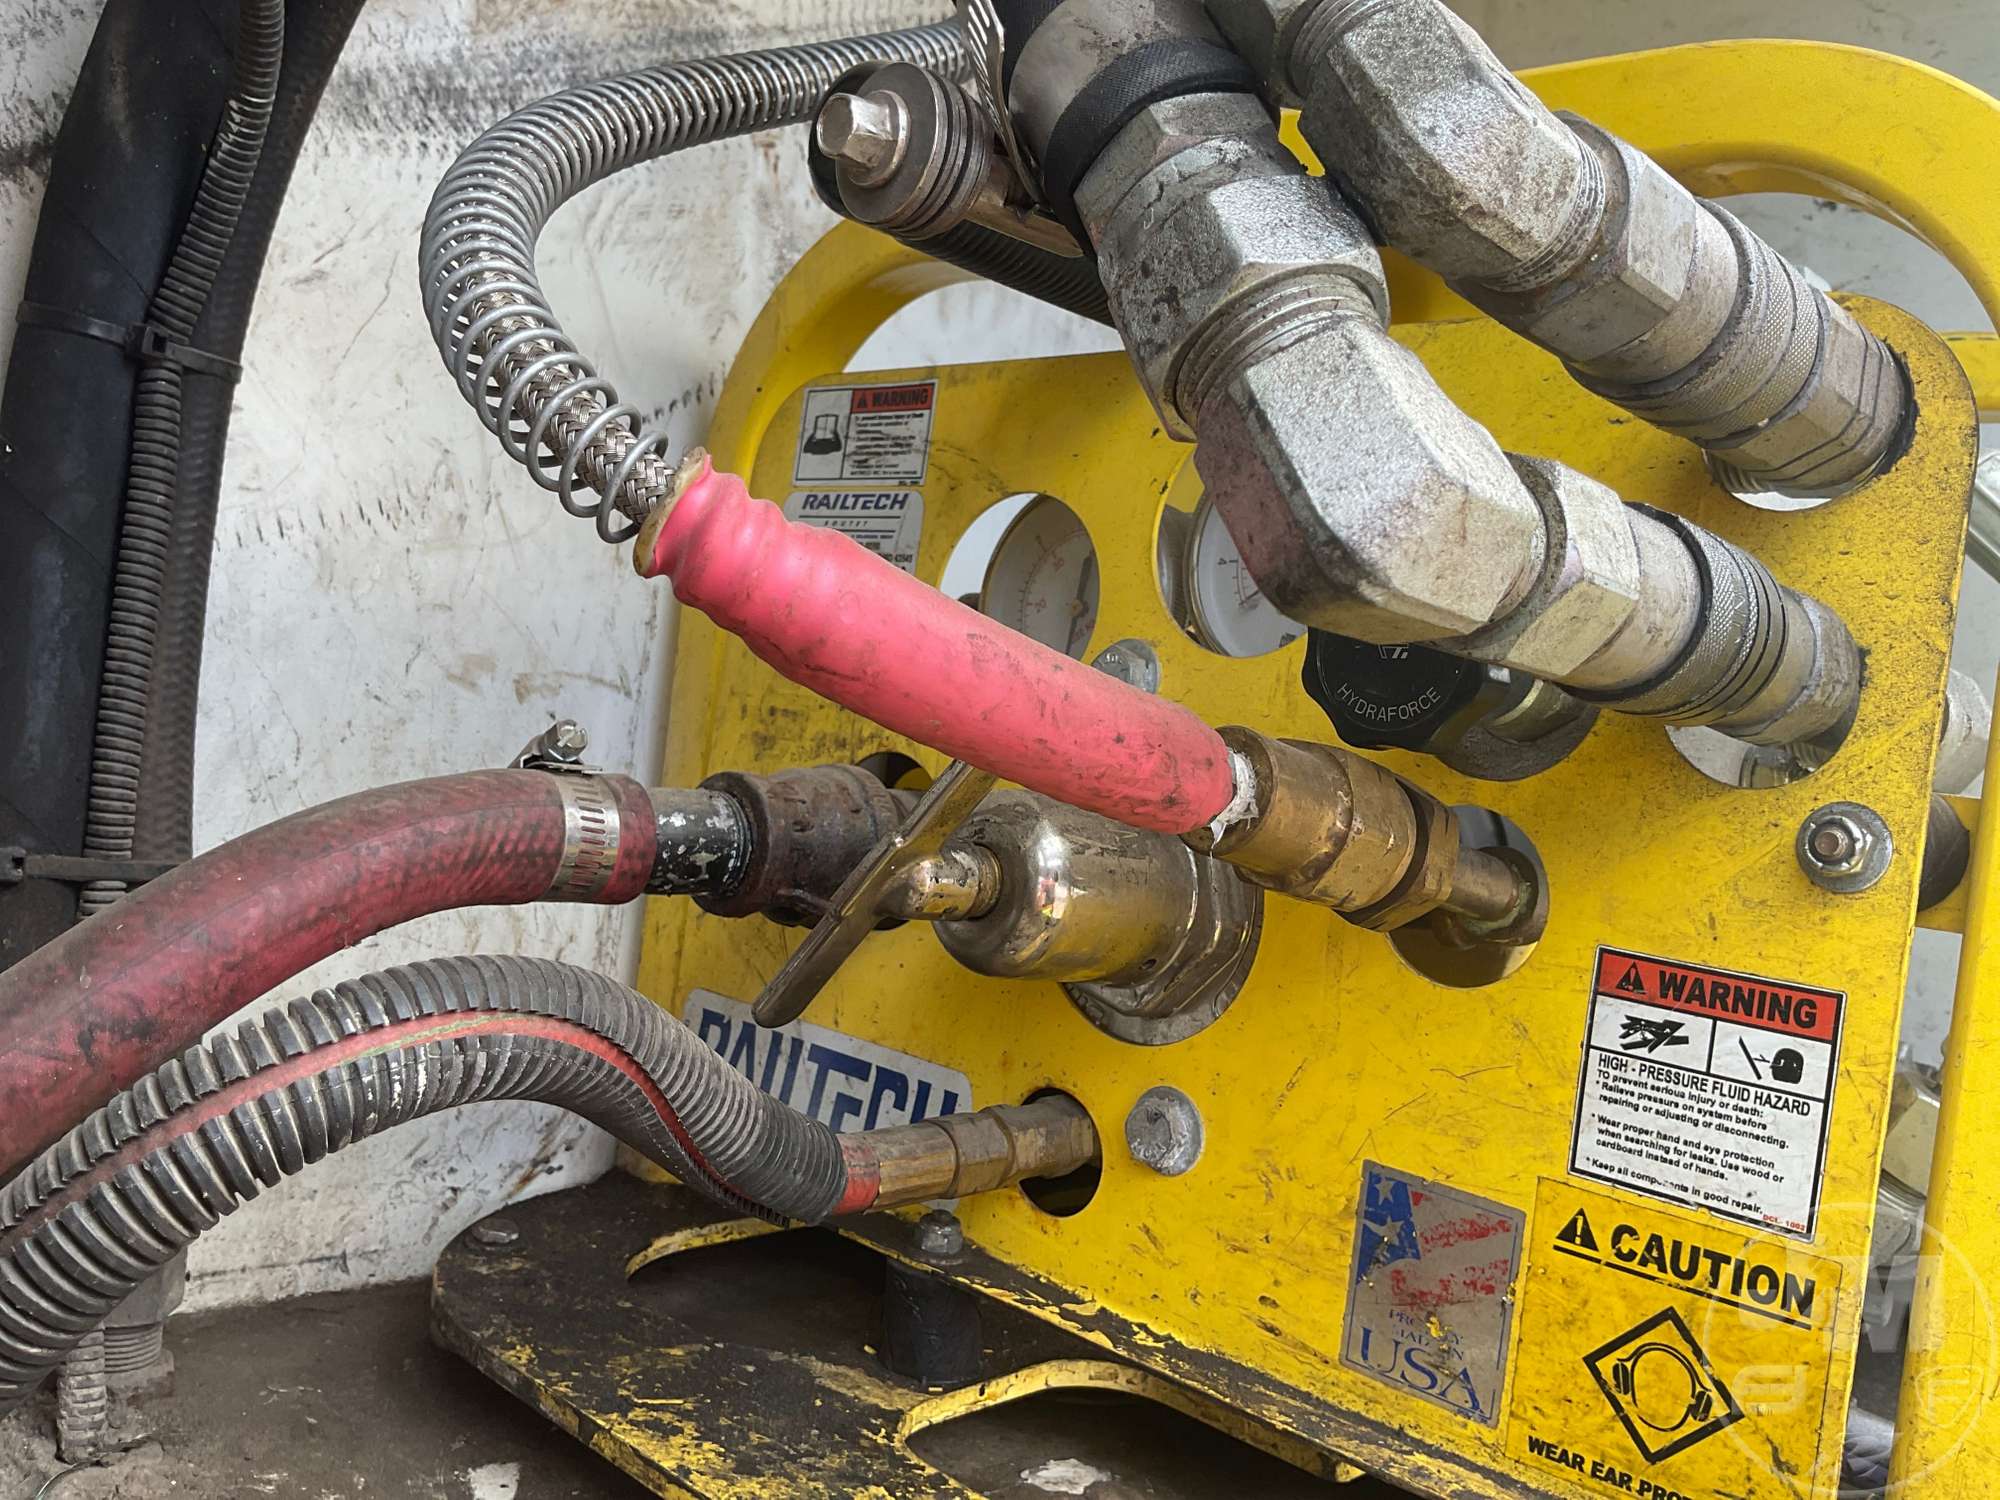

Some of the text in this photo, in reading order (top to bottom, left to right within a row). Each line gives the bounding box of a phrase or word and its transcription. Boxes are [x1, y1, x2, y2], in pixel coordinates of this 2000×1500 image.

[872, 388, 928, 409] WARNING
[802, 493, 909, 510] RAILTECH
[1336, 683, 1441, 722] HYDRAFORCE
[1659, 970, 1817, 1029] WARNING
[1598, 1053, 1629, 1073] HIGH
[1638, 1063, 1709, 1093] PRESSURE
[1711, 1080, 1751, 1102] FLUID
[1753, 1090, 1811, 1116] HAZARD
[1612, 1075, 1648, 1090] prevent
[1650, 1084, 1686, 1099] serious
[1688, 1091, 1717, 1108] injury
[1718, 1101, 1730, 1109] or
[1732, 1103, 1764, 1118] death:
[1637, 1092, 1680, 1109] pressure
[1682, 1103, 1695, 1113] on
[1697, 1107, 1733, 1122] system
[1735, 1115, 1767, 1131] before
[1597, 1114, 1775, 1169] Wear proper hand and eye protection
[1599, 1094, 1789, 1150] repairing or adjusting or disconnecting.
[1596, 1139, 1728, 1181] cardboard instead of hands.
[1597, 1127, 1785, 1183] when searching for leaks. Use wood or
[1591, 1158, 1615, 1173] Keep
[1617, 1167, 1629, 1176] all
[1691, 1186, 1701, 1197] in
[1703, 1191, 1729, 1204] good
[1731, 1199, 1763, 1214] repair.
[1611, 1224, 1815, 1318] CAUTION
[1360, 1326, 1484, 1415] USA
[1528, 1435, 1692, 1500] WEAR EAR PRO
